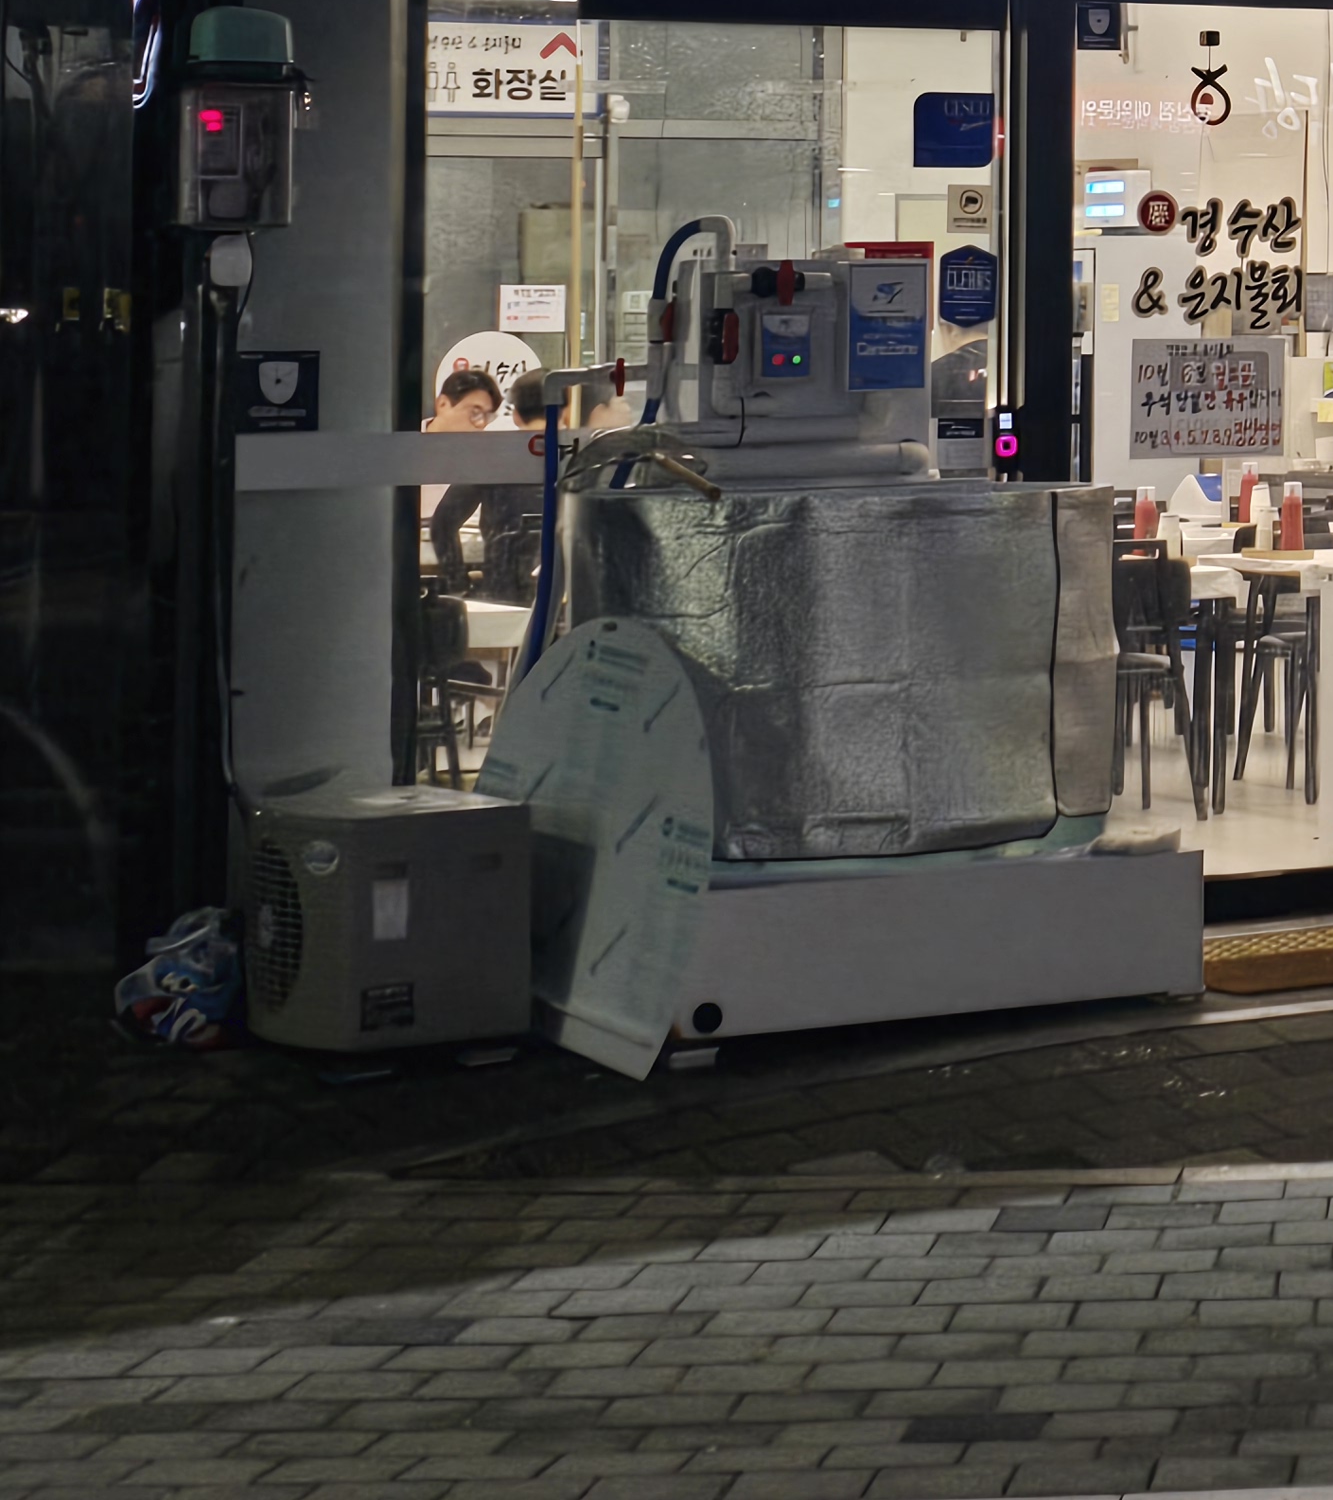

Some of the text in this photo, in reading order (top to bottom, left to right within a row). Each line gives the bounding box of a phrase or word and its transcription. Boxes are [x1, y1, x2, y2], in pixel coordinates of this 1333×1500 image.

[472, 67, 566, 100] 화장실
[1135, 265, 1303, 329] & 은지물회
